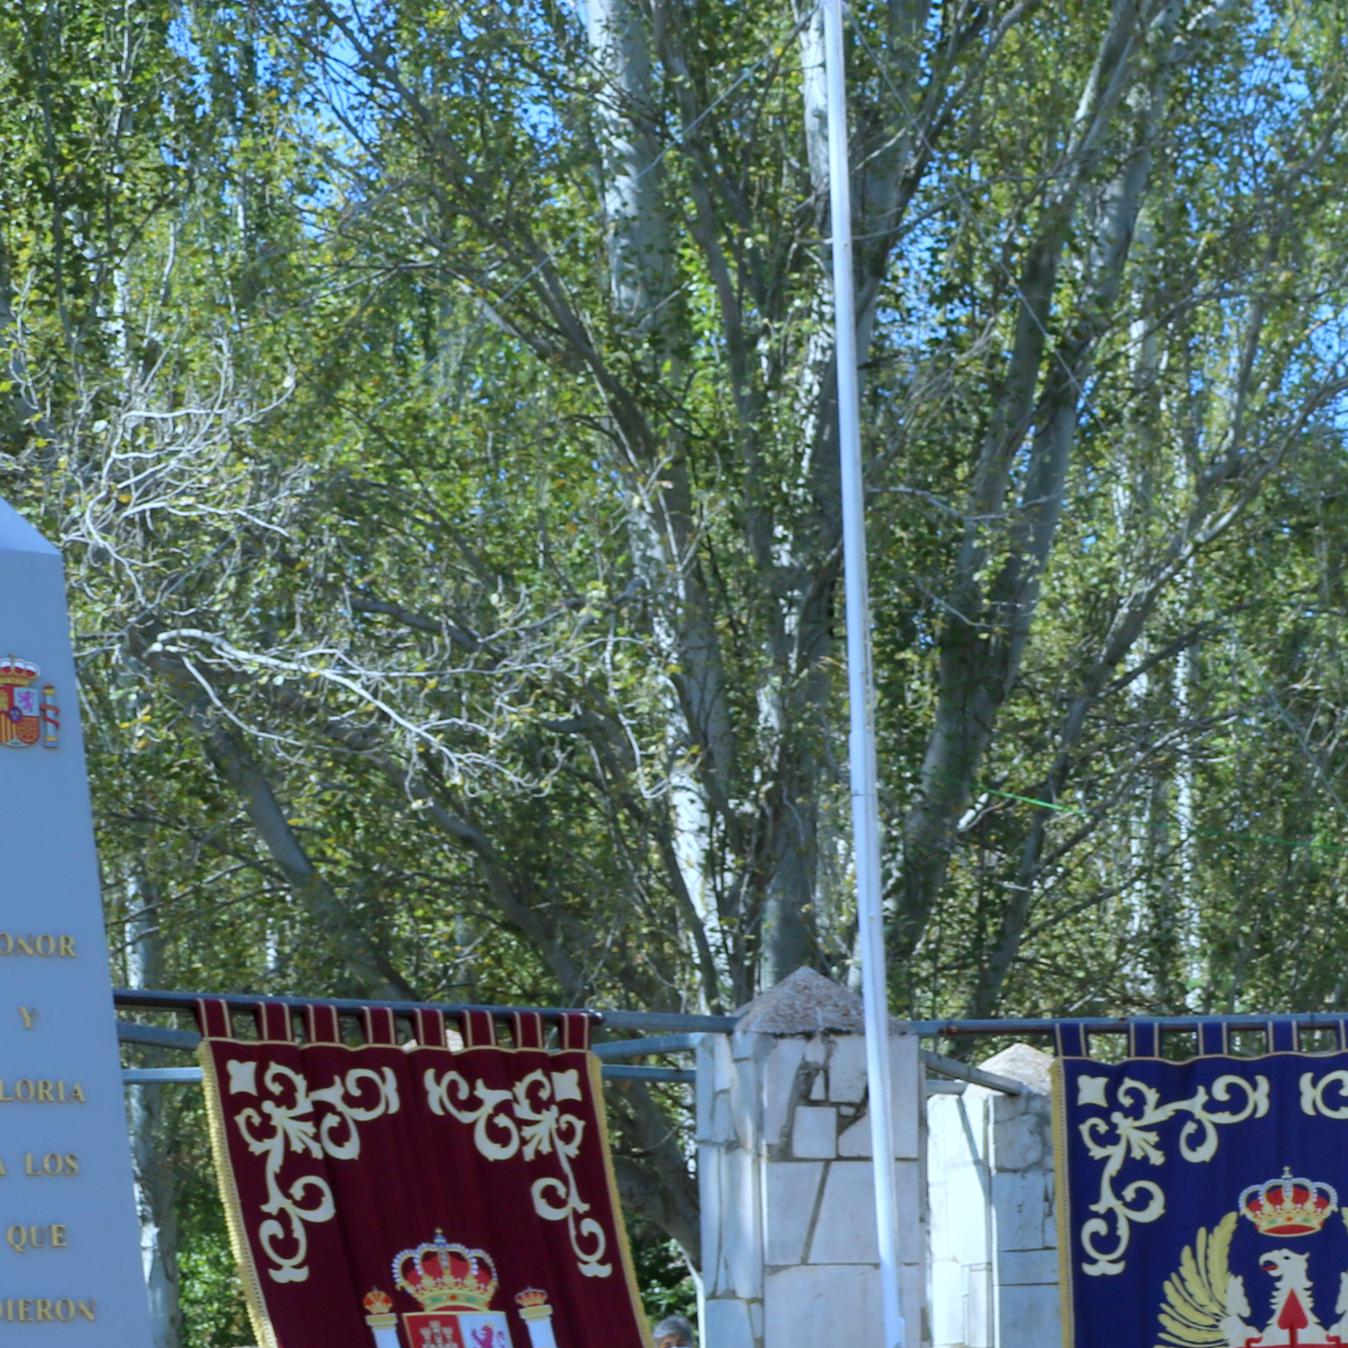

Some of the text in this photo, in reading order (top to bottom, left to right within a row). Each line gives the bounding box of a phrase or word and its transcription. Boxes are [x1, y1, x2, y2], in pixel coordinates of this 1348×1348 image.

[19, 1006, 37, 1030] Y
[25, 1152, 79, 1176] LOS
[6, 1224, 68, 1253] QUE
[0, 1298, 95, 1322] IERON
